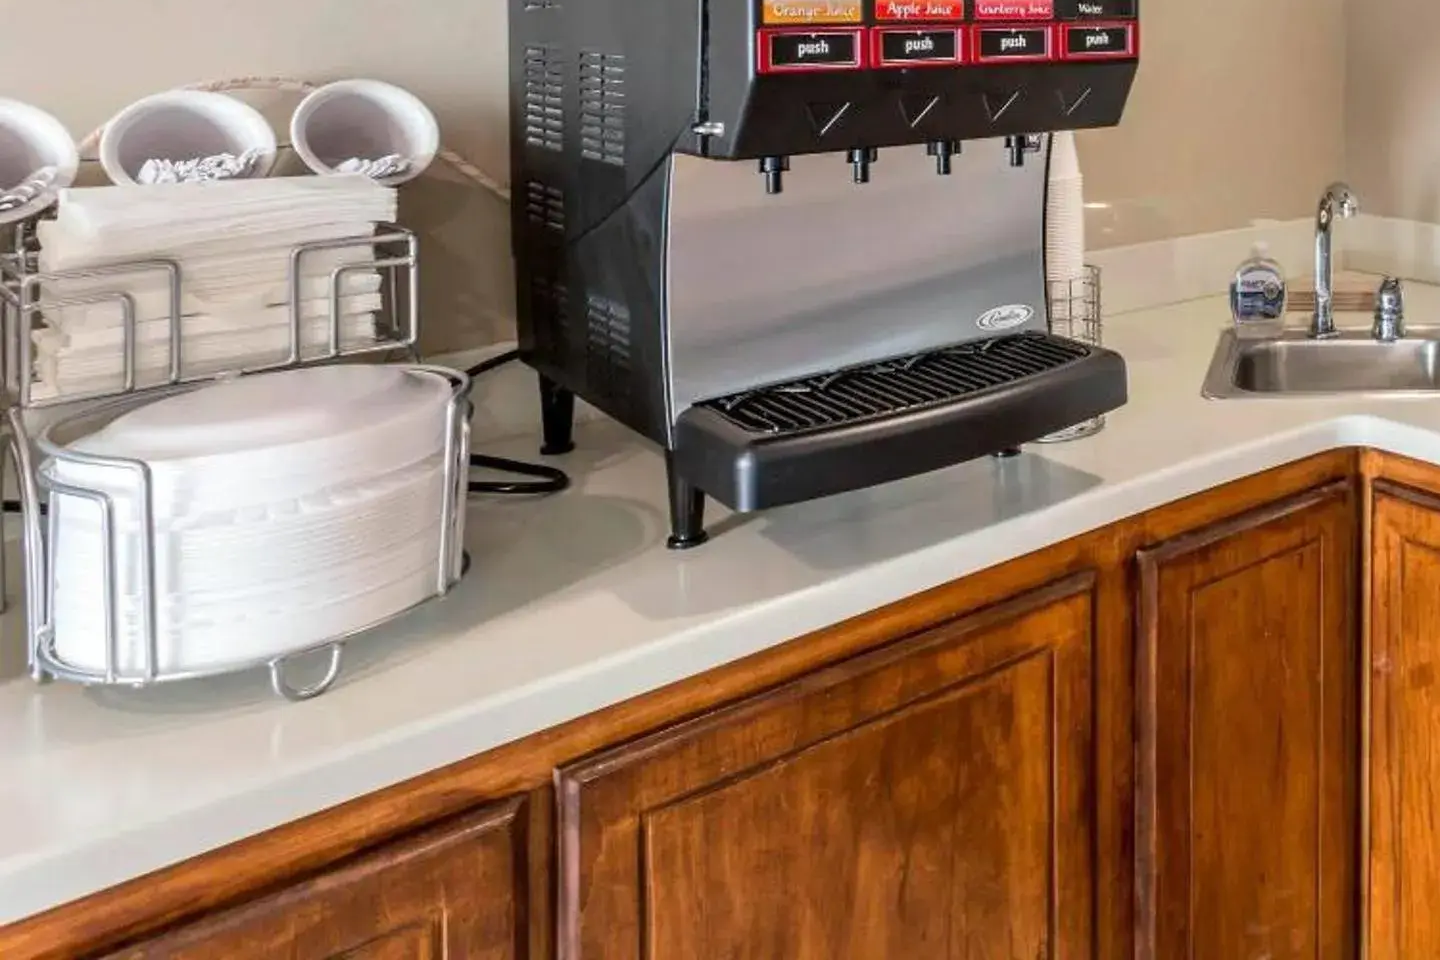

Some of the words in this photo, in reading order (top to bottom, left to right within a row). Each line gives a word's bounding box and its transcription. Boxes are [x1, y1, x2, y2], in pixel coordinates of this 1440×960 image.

[772, 3, 820, 21] Orange
[825, 2, 855, 17] Juice
[886, 1, 920, 19] Apple
[923, 1, 953, 15] Juice
[978, 3, 1026, 18] Cranberry
[1027, 3, 1051, 15] Juice
[1078, 2, 1103, 14] Water
[905, 36, 934, 55] push
[1001, 35, 1027, 51] push
[1085, 32, 1110, 48] push
[797, 40, 830, 58] push
